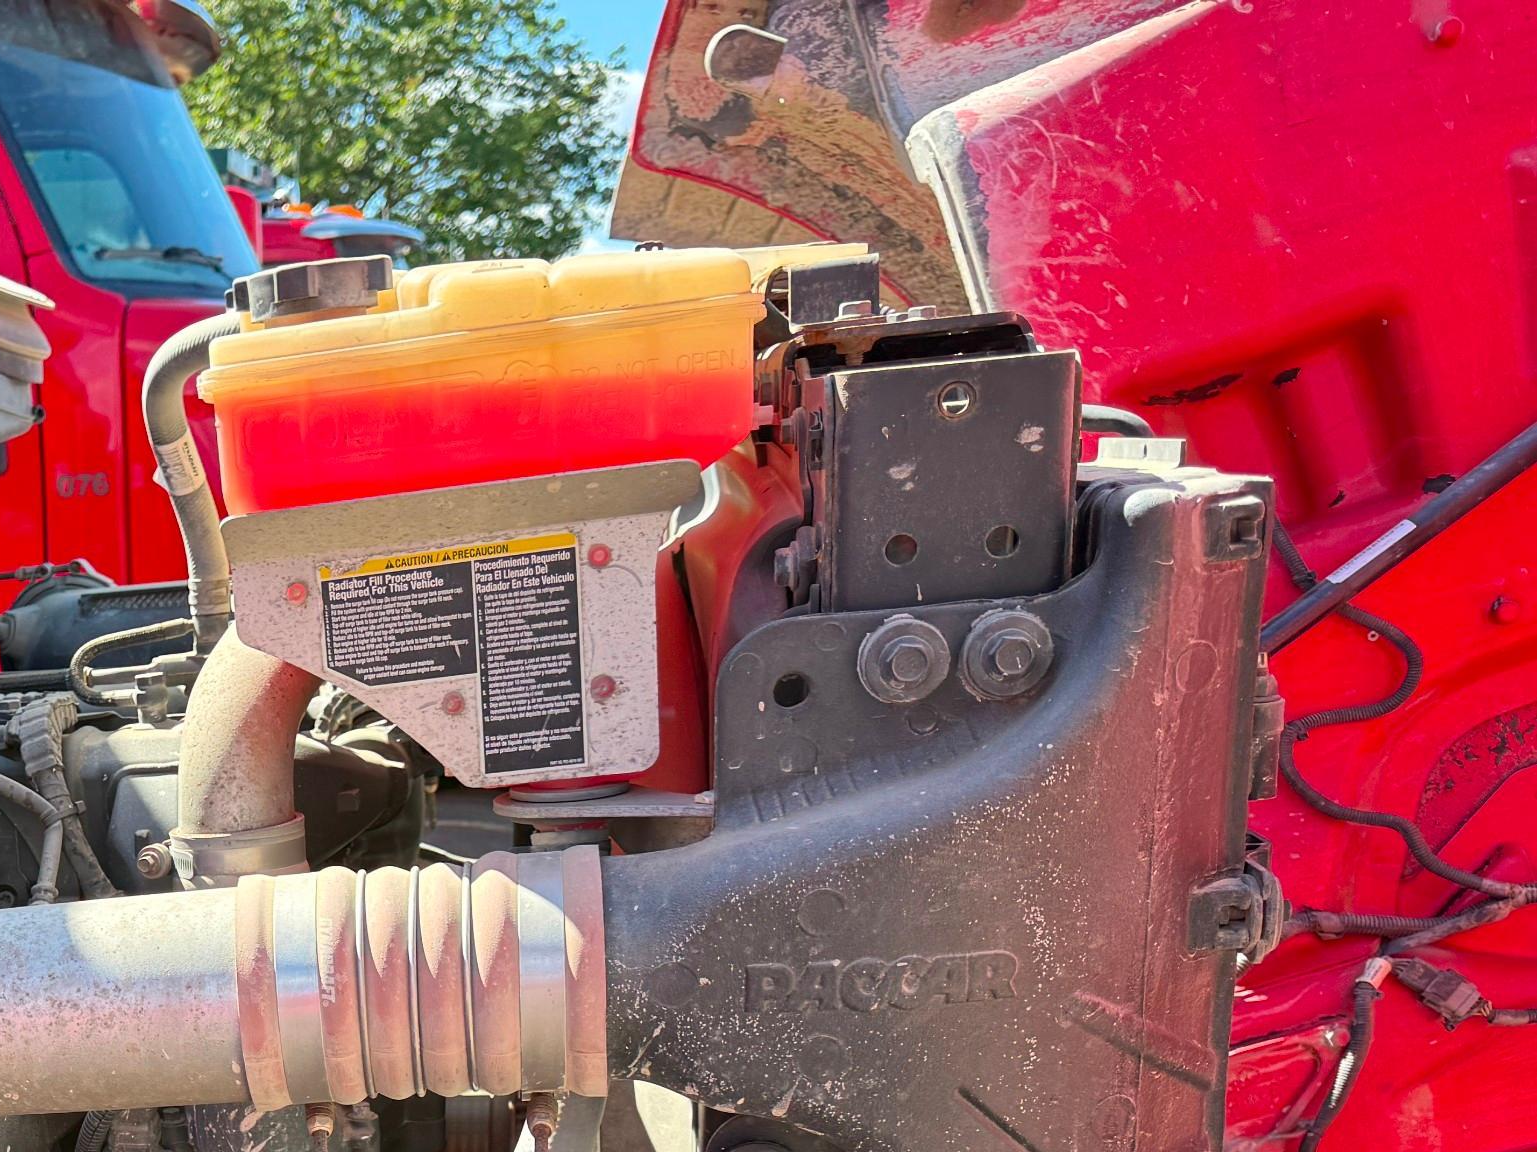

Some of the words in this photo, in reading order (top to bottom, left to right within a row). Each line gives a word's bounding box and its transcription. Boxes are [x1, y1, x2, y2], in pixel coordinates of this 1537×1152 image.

[676, 348, 735, 374] OPEN
[56, 472, 110, 498] 076
[395, 554, 433, 568] CAUTION
[452, 544, 509, 560] PRECAUCION
[475, 556, 529, 571] Procedimiento
[531, 551, 570, 567] Requerido
[328, 579, 366, 592] Radiator
[369, 576, 383, 586] Fill
[385, 570, 432, 584] Procedure
[476, 573, 492, 582] Para
[495, 571, 502, 579] El
[504, 567, 533, 578] Llenado
[535, 565, 548, 575] Del
[476, 582, 509, 593] Radiador
[512, 579, 521, 588] En
[524, 577, 540, 587] Este
[329, 587, 369, 602] Required
[372, 586, 387, 597] For
[390, 583, 408, 595] This
[411, 577, 444, 590] Vehicle
[745, 950, 1017, 1013] PACCAR
